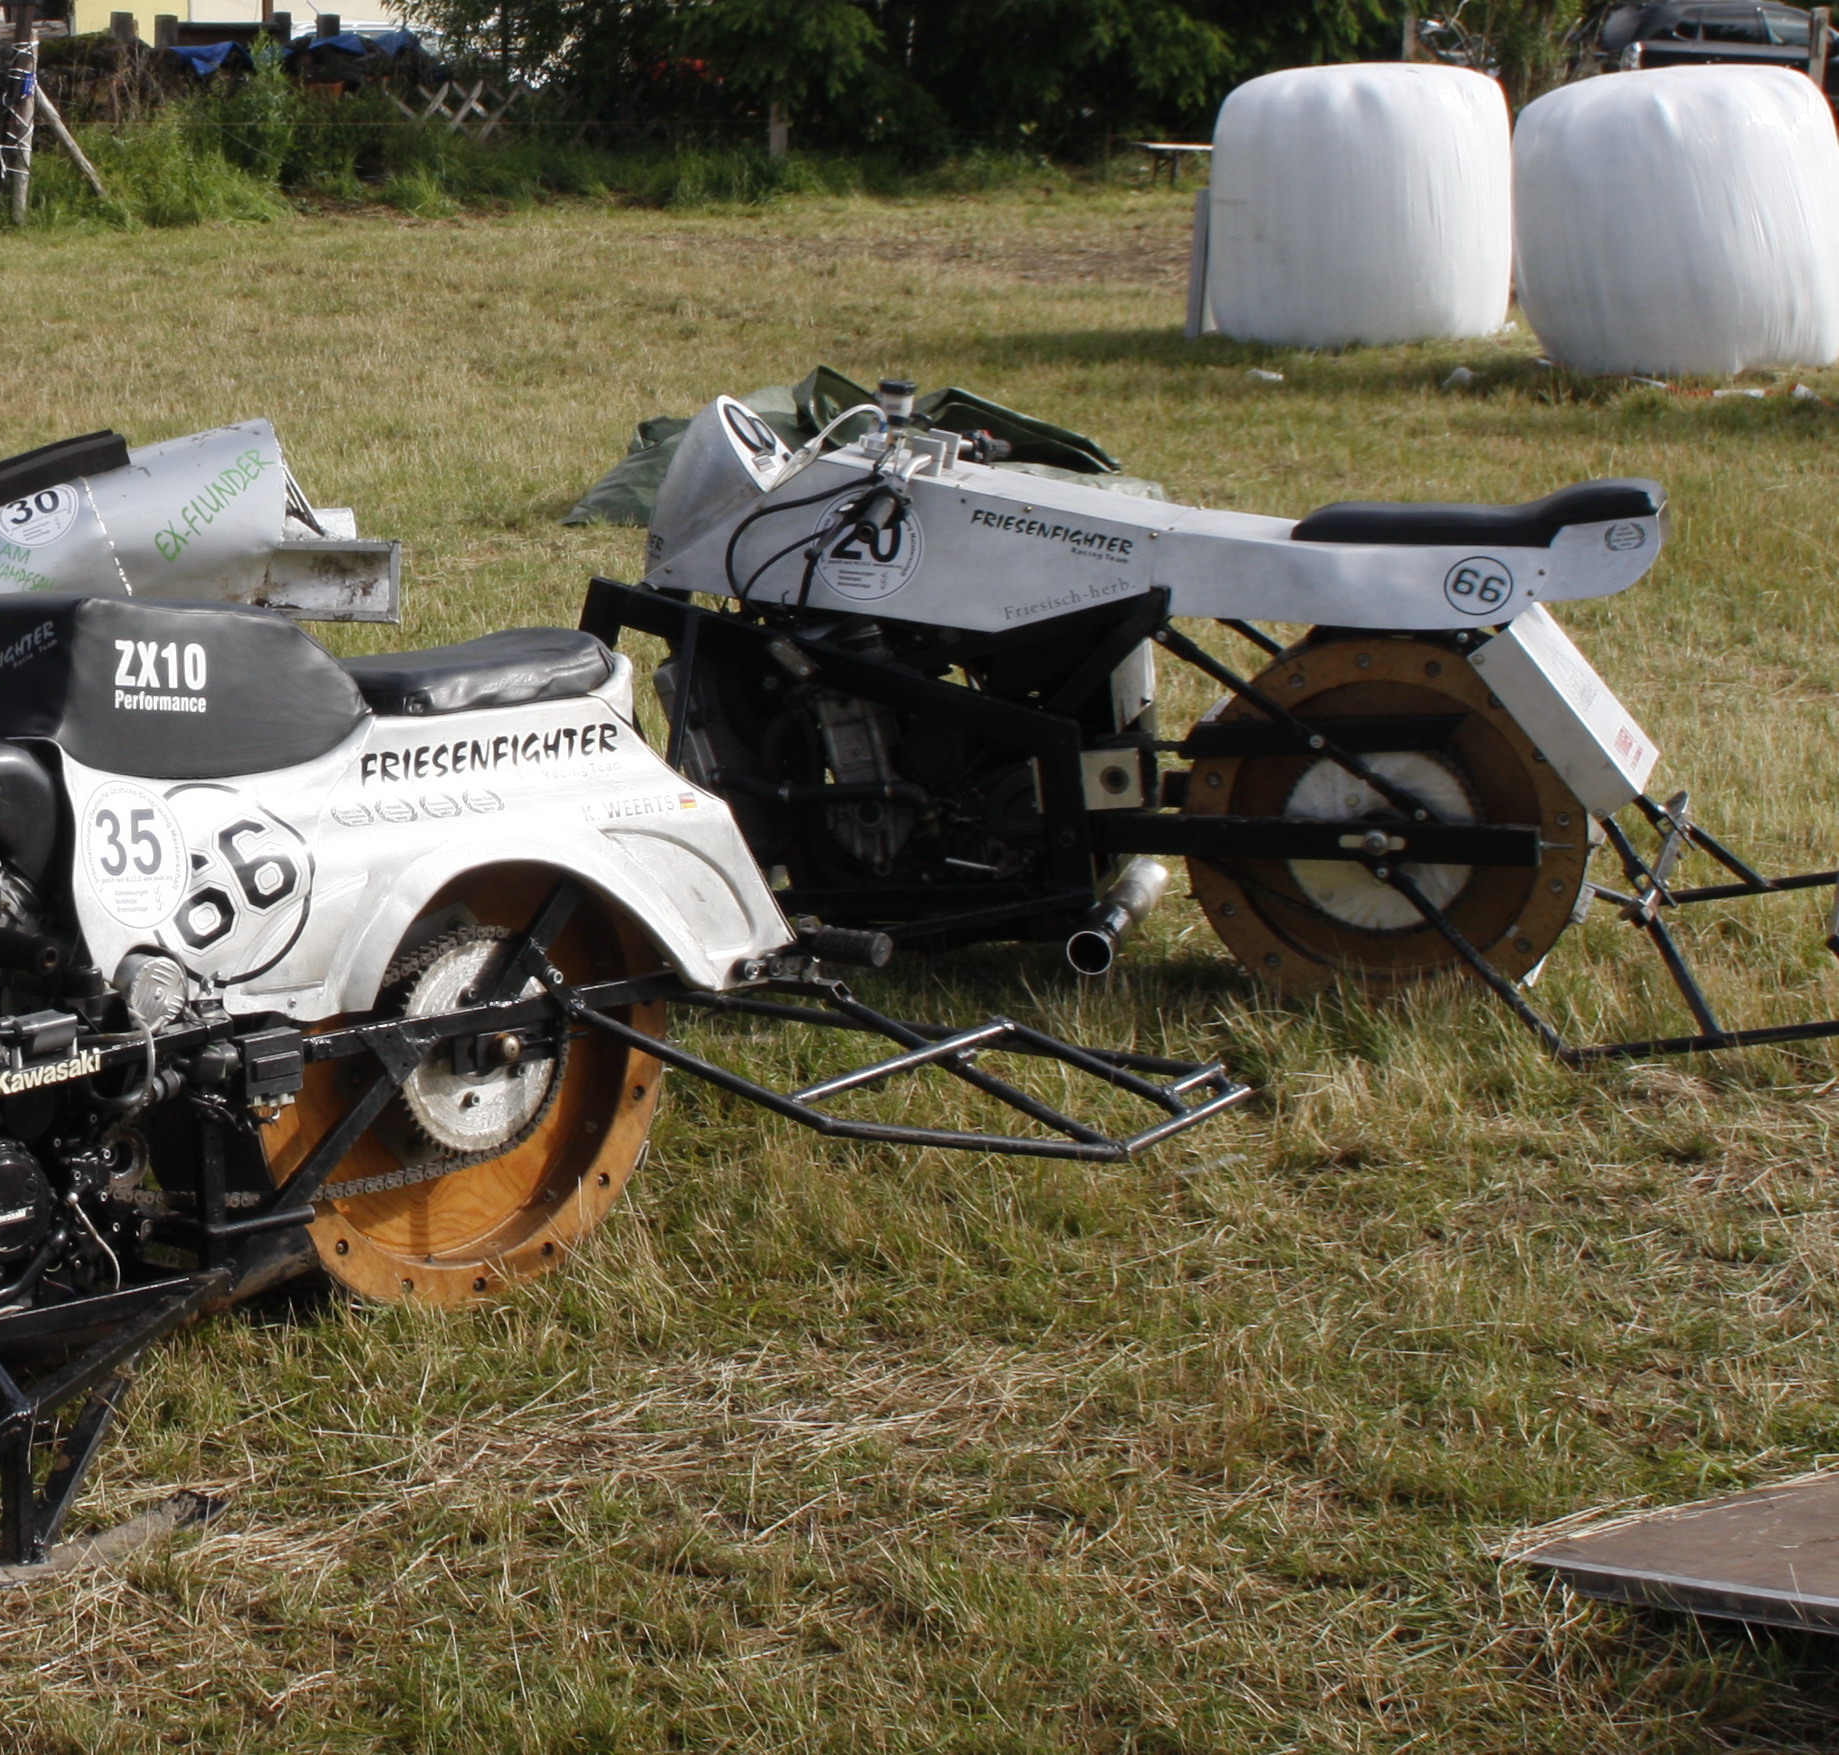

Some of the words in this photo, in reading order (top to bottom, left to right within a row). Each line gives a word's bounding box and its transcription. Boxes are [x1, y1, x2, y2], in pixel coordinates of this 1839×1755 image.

[6, 490, 60, 525] 30
[154, 449, 276, 562] EX-FLUNDER
[829, 515, 902, 563] 20
[971, 509, 1134, 555] FRIESENFIGHTER
[1070, 546, 1103, 560] Racing
[1104, 553, 1129, 565] Team
[1004, 577, 1136, 621] Friesisch-herb.
[1451, 567, 1506, 603] 66
[114, 639, 207, 691] ZX10
[114, 690, 207, 713] Performance
[360, 723, 619, 788] FRIESENFIGHTER
[95, 808, 162, 876] 35
[171, 817, 300, 953] 66
